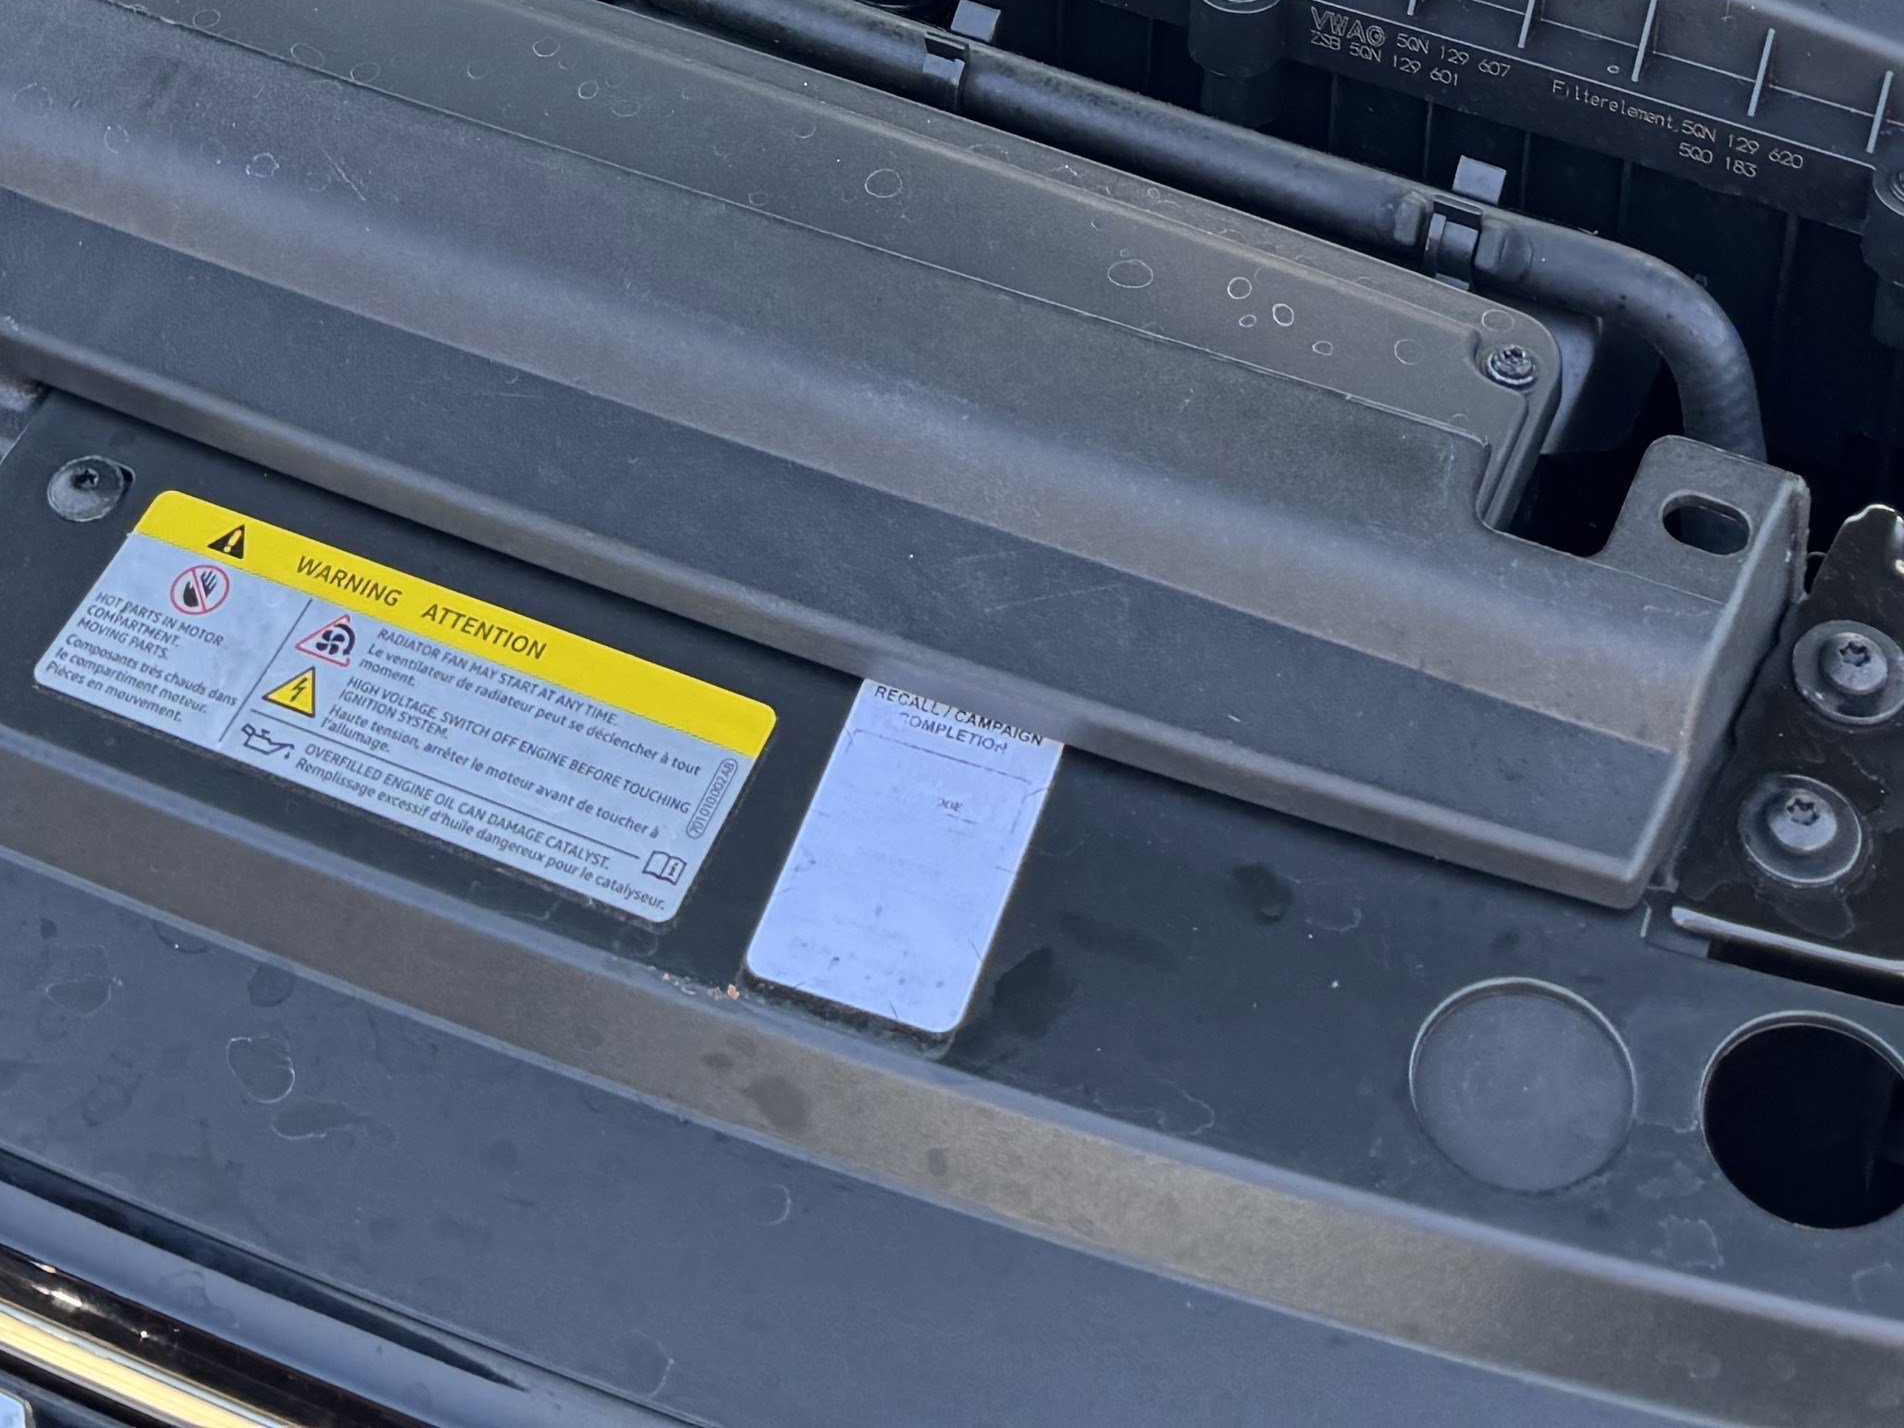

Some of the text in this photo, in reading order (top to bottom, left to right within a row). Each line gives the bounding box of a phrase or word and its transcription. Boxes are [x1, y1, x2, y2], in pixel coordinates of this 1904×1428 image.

[1349, 39, 1382, 64] 5QN
[1392, 52, 1423, 75] 129
[1430, 65, 1460, 87] 601
[1396, 32, 1430, 56] 5QN
[1439, 43, 1470, 66] 129
[1479, 56, 1512, 79] 607
[1681, 118, 1719, 144] 5QN
[1727, 132, 1761, 156] 129
[1769, 146, 1805, 171] 620
[1724, 156, 1758, 180] 183
[85, 605, 184, 647] COMPARTMENT.
[95, 592, 225, 646] HOT PARTS IN MOTOR
[296, 556, 548, 658] WARNING ATTENTION
[77, 617, 171, 659] MOVING PARTS.
[55, 647, 210, 713] le compartiment moteur.
[64, 634, 141, 668] Composants
[163, 671, 208, 694] chauds
[207, 688, 239, 705] dans
[360, 659, 417, 686] moment.
[378, 628, 620, 725] RADIATOR FAN MAY START AT ANY TIME.
[87, 678, 104, 690] en
[103, 686, 186, 721] mouvement.
[339, 690, 450, 738] IGNITION SYSTEM.
[368, 644, 700, 775] Le ventilateur de radiateur peut se déclencher tout
[875, 685, 1044, 746] RECALL CAMPAIGN
[319, 718, 394, 752] l'allumage.
[348, 677, 380, 694] HIGH
[440, 712, 491, 737] SWITCH
[492, 731, 518, 746] OFF
[518, 742, 567, 766] ENGINE
[567, 760, 622, 786] BEFORE
[621, 781, 692, 813] TOUCHING
[330, 706, 650, 833] Haute tension, arrêter moteur avant de toucher
[302, 744, 613, 869] OVERFILLED ENGINE OIL CAN DAMAGE CATALYST.
[292, 759, 667, 912] Remplissage excessif d'huile dangereux pour catalyseur.
